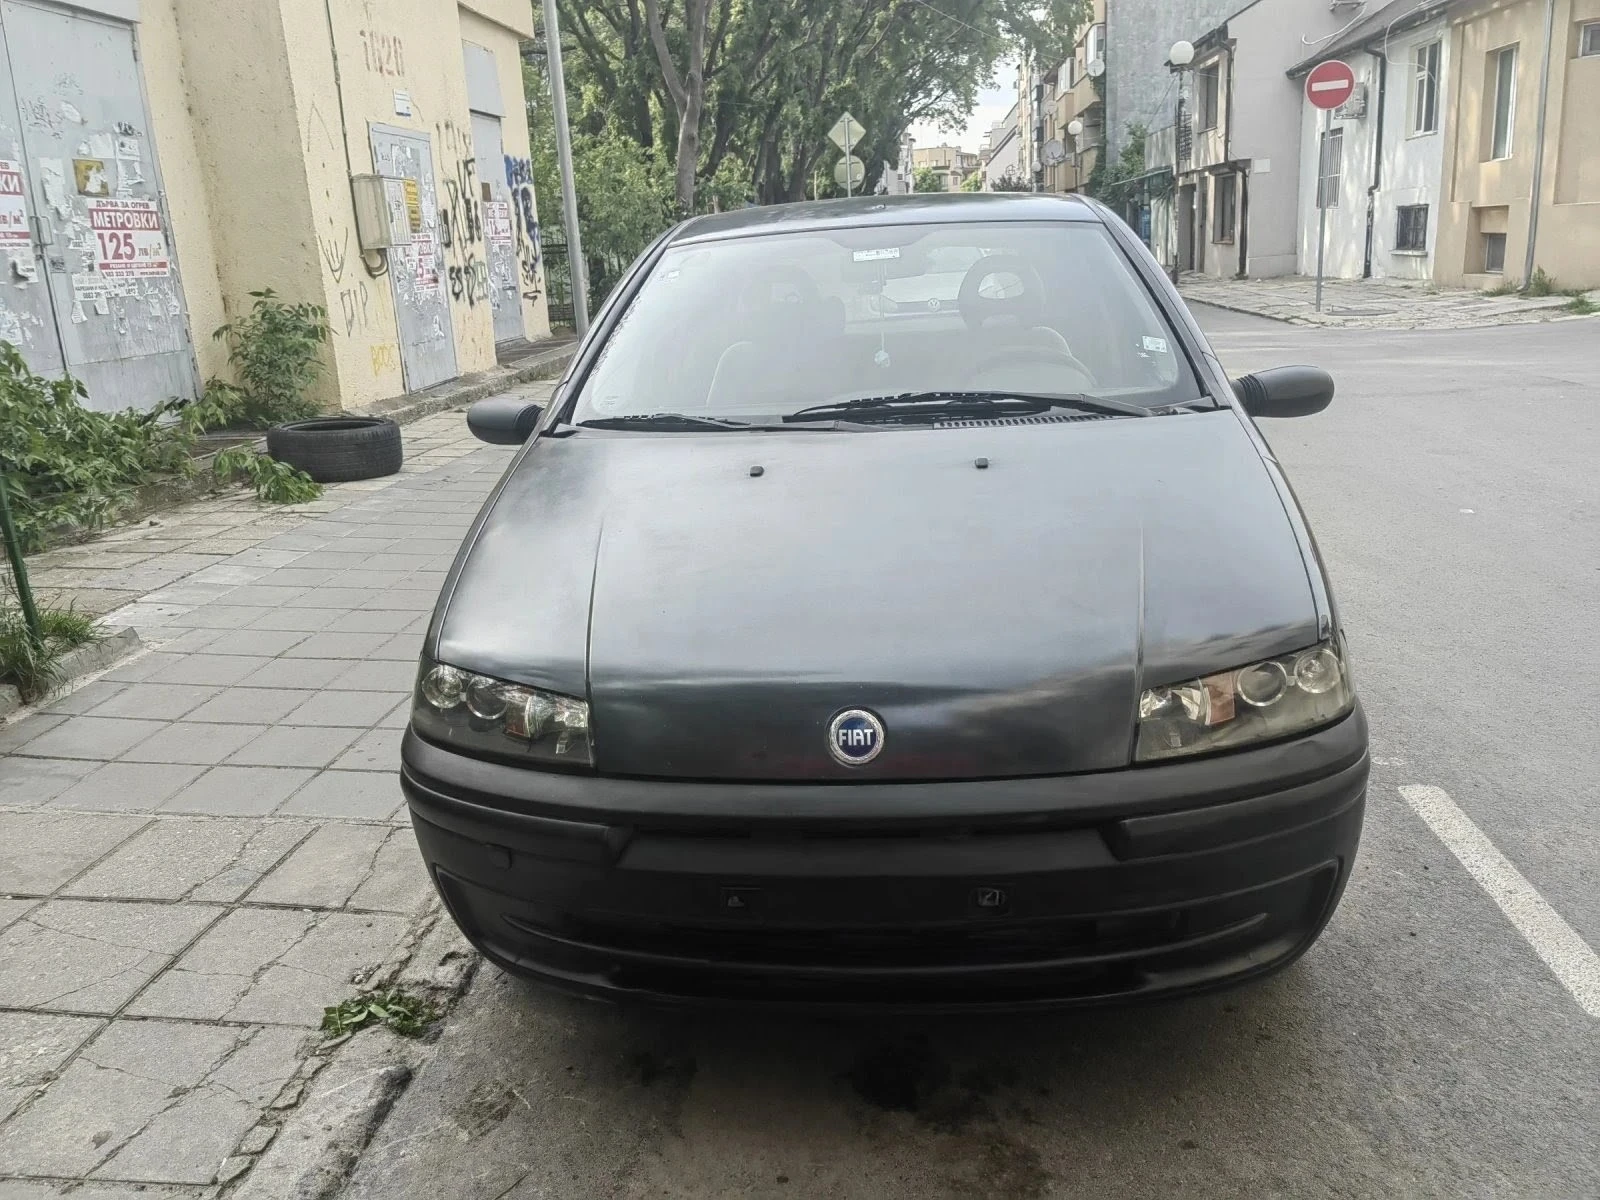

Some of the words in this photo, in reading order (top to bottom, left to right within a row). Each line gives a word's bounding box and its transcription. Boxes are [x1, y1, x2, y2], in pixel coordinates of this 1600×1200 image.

[121, 201, 130, 209] ЗА
[131, 201, 150, 209] ОГРЕВ
[93, 211, 159, 228] МЕТРОВКИ
[97, 232, 136, 260] 125
[838, 728, 874, 746] FIAT
